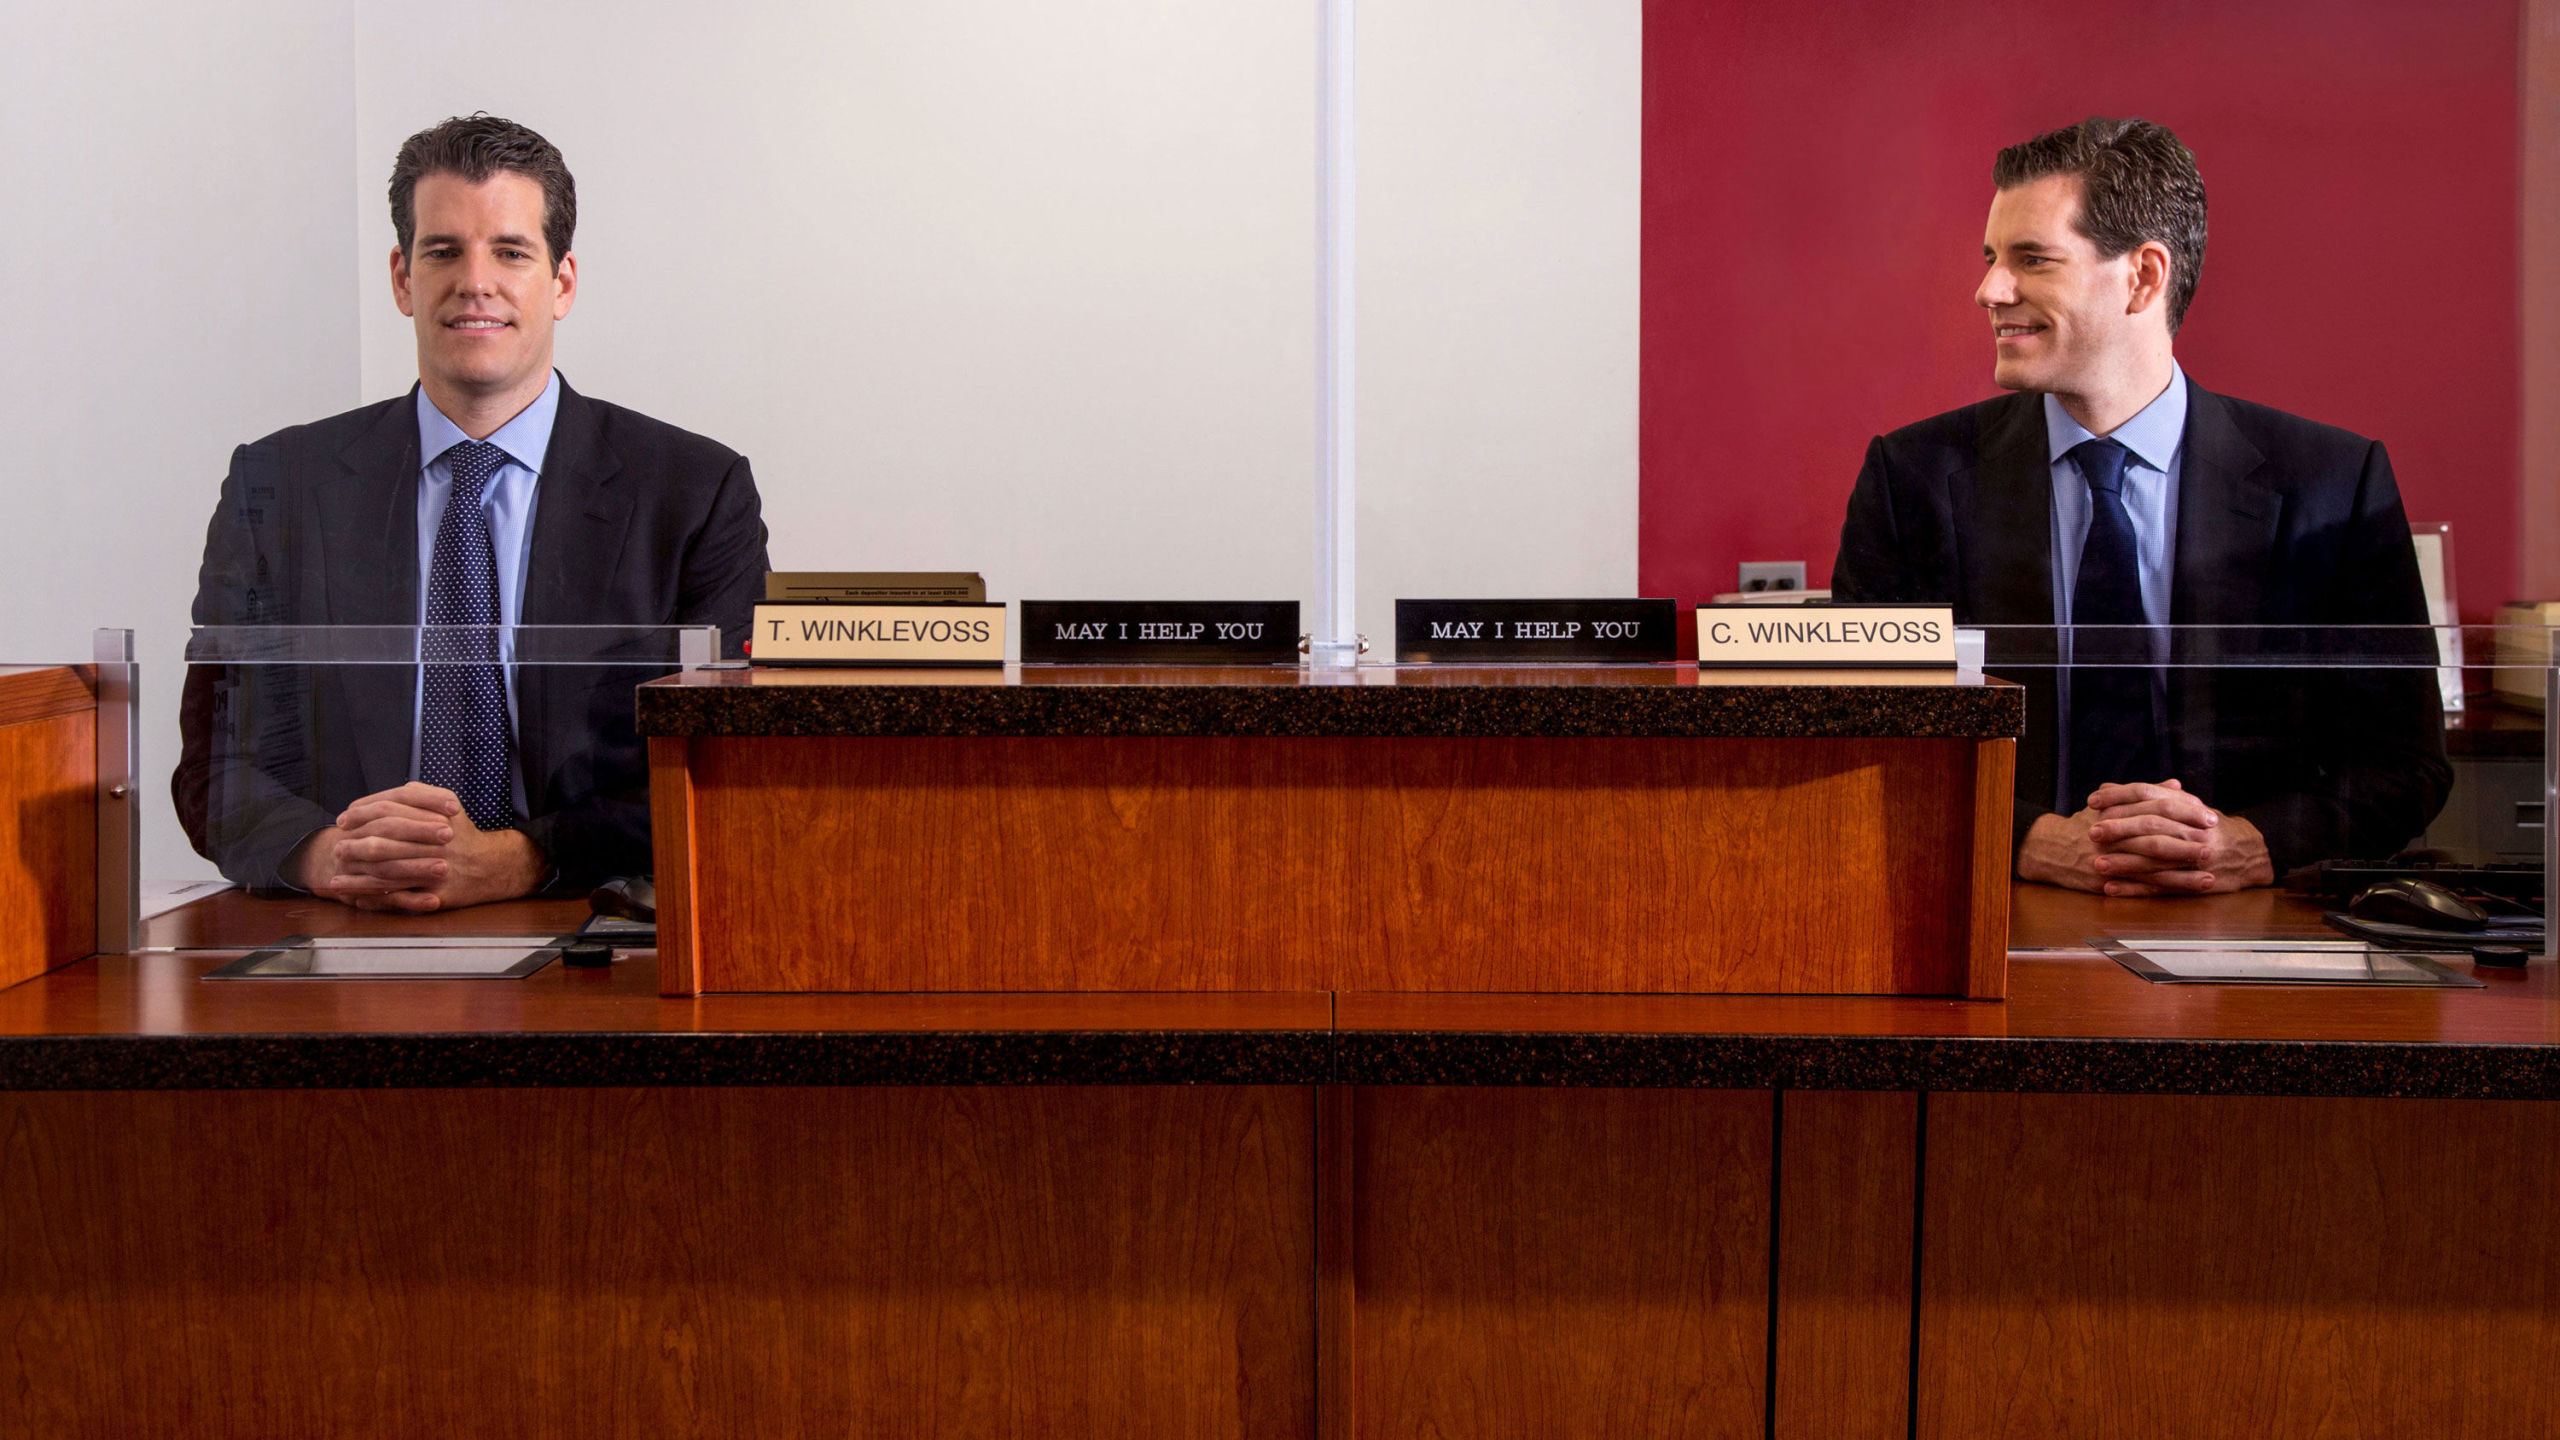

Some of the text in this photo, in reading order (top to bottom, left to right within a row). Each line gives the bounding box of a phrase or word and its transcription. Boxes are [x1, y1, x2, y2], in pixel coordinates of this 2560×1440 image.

[767, 620, 990, 643] T. WINKLEVOSS
[1055, 622, 1264, 640] MAY I HELP YOU
[1430, 621, 1641, 639] MAY I HELP YOU
[1711, 621, 1941, 644] C. WINKLEVOSS
